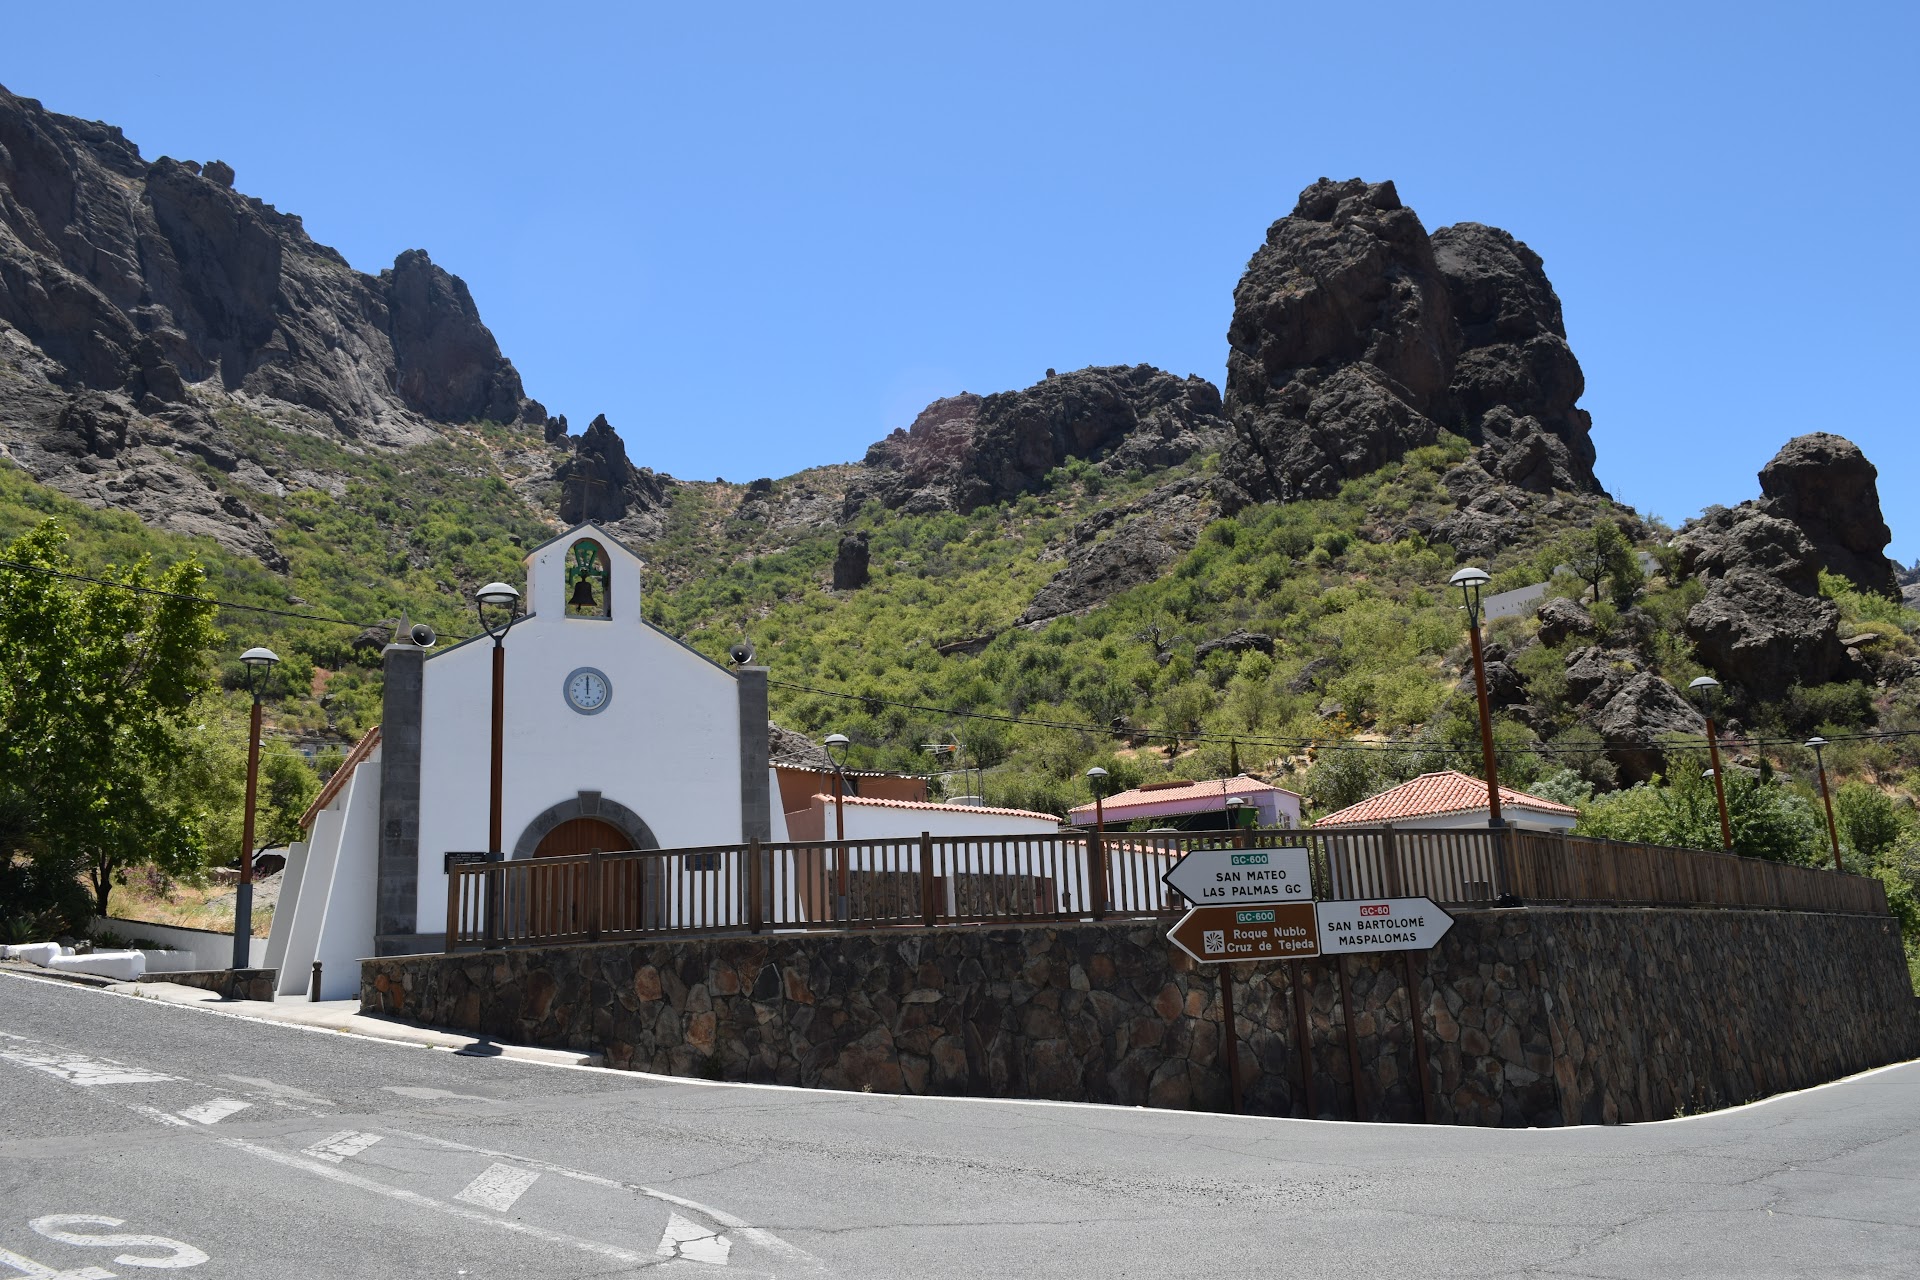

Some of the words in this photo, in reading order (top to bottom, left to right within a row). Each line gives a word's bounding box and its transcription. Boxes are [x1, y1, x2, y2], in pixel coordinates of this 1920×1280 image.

[1233, 855, 1267, 864] GC-600
[1216, 872, 1241, 882] SAN
[1247, 870, 1287, 880] MATEO
[1203, 887, 1225, 897] LAS
[1232, 885, 1279, 896] PALMAS
[1285, 884, 1301, 894] GC
[1238, 912, 1273, 921] GC-600
[1361, 906, 1389, 916] GC-60
[1328, 921, 1351, 931] SAN
[1357, 916, 1425, 930] BARTOLOMÉ
[1233, 929, 1268, 940] Roque
[1273, 926, 1307, 937] Nublo
[1339, 932, 1417, 945] MASPALOMAS
[1227, 942, 1252, 952] Cruz
[1258, 941, 1272, 951] de
[1278, 939, 1315, 951] Tejeda
